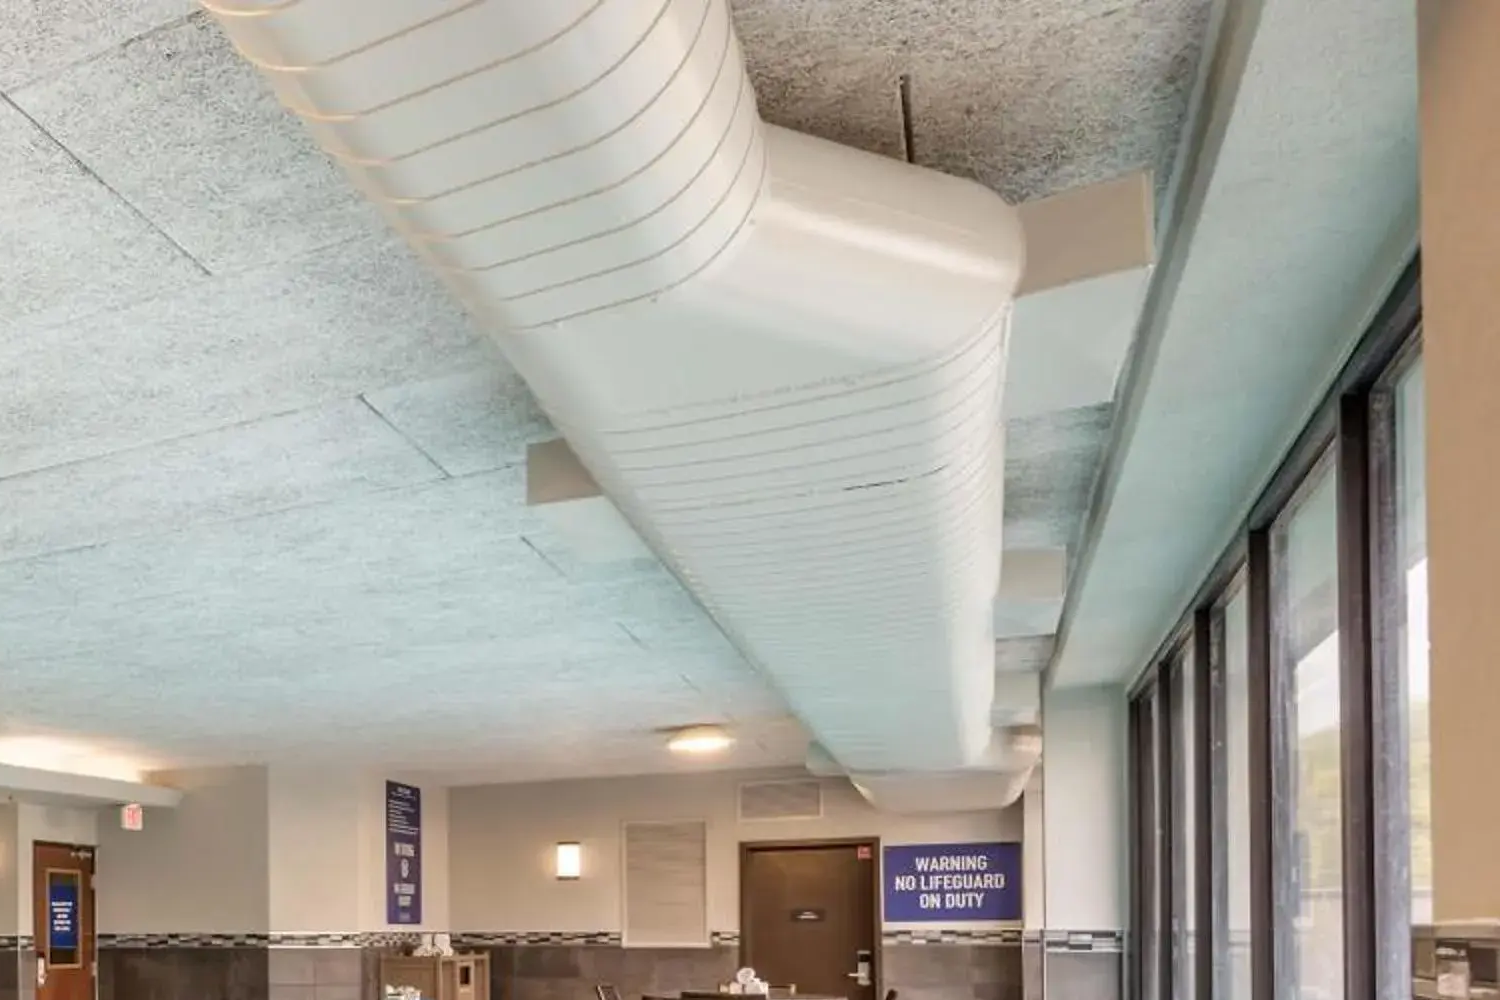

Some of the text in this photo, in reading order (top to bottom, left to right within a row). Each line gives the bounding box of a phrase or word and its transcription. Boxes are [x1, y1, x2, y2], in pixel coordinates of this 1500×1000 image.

[915, 855, 987, 871] WARNING
[895, 873, 1005, 891] NO LIFEGUARD
[919, 892, 984, 909] ON DUTY
